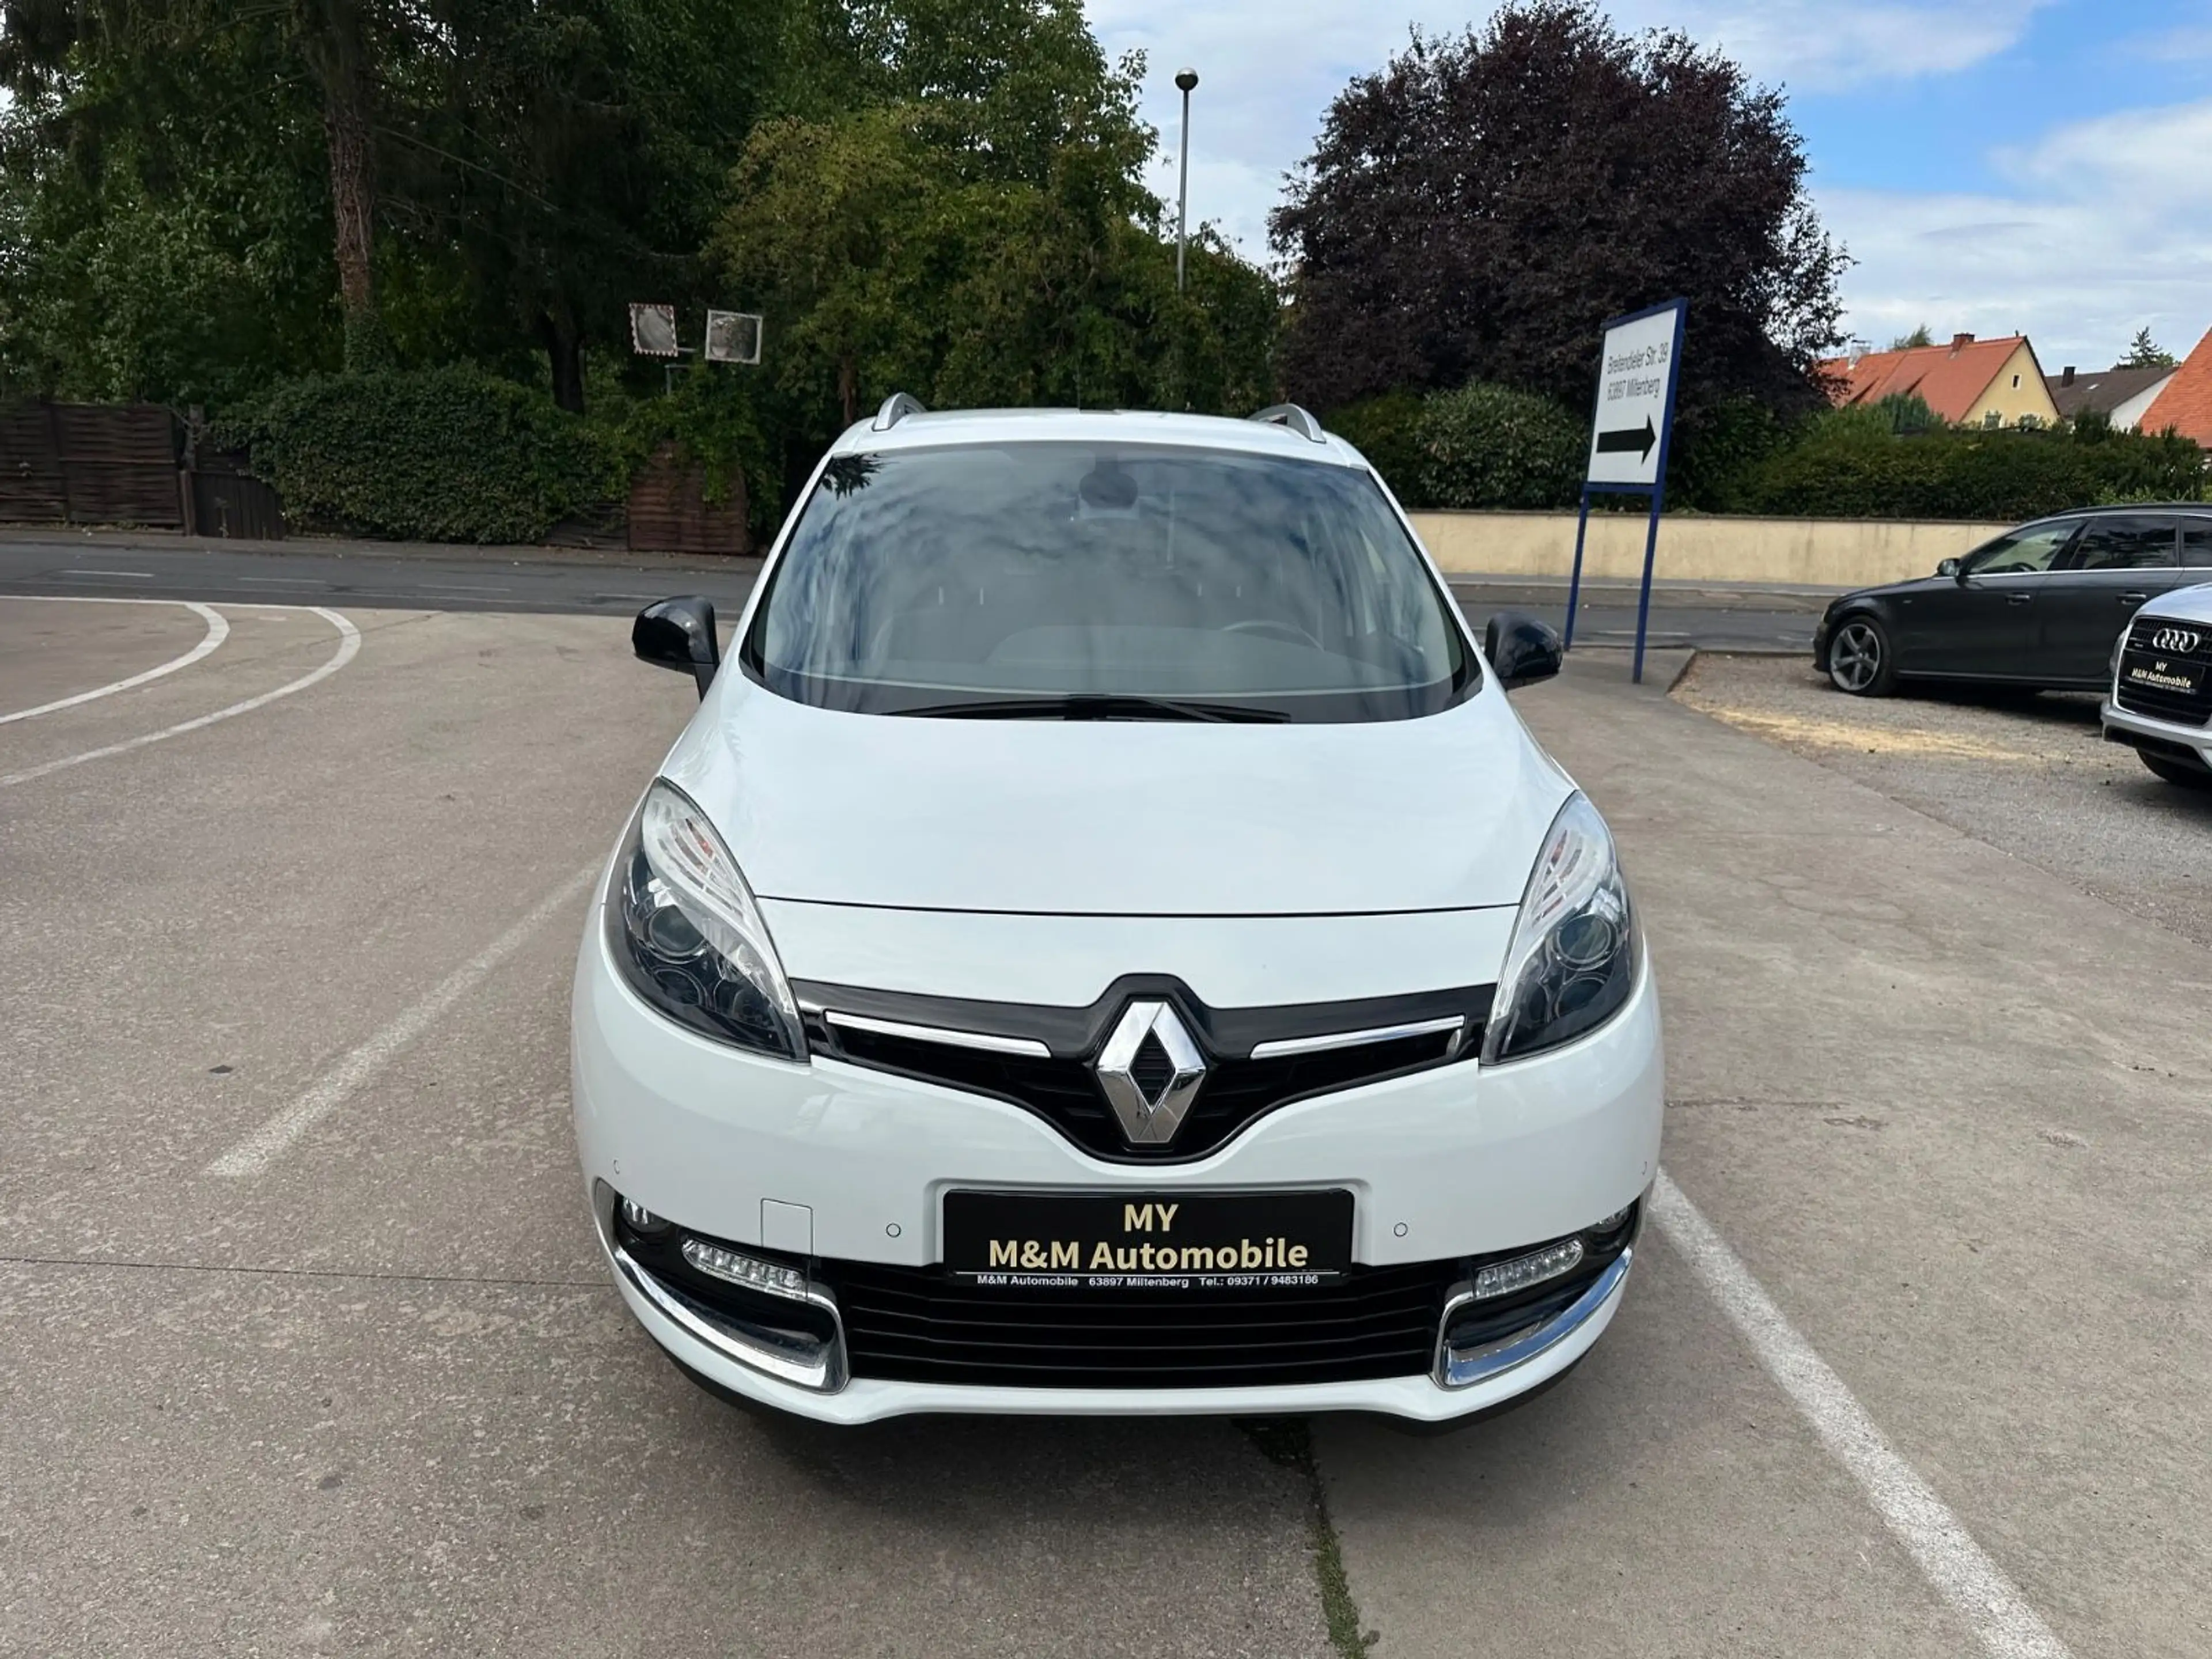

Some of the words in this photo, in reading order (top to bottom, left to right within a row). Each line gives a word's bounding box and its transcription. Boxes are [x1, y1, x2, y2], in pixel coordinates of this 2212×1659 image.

[2147, 671, 2191, 688] Automobile
[1124, 1203, 1179, 1232] MY
[989, 1240, 1080, 1268] M&M
[1089, 1237, 1308, 1270] Automobile
[977, 1274, 1007, 1285] M&M
[1010, 1275, 1079, 1286] Automobile
[1089, 1277, 1123, 1286] 63897
[1126, 1277, 1189, 1289] Miltenberg
[1199, 1277, 1224, 1286] Tel.:
[1228, 1275, 1260, 1286] 09371
[1263, 1275, 1268, 1286] /
